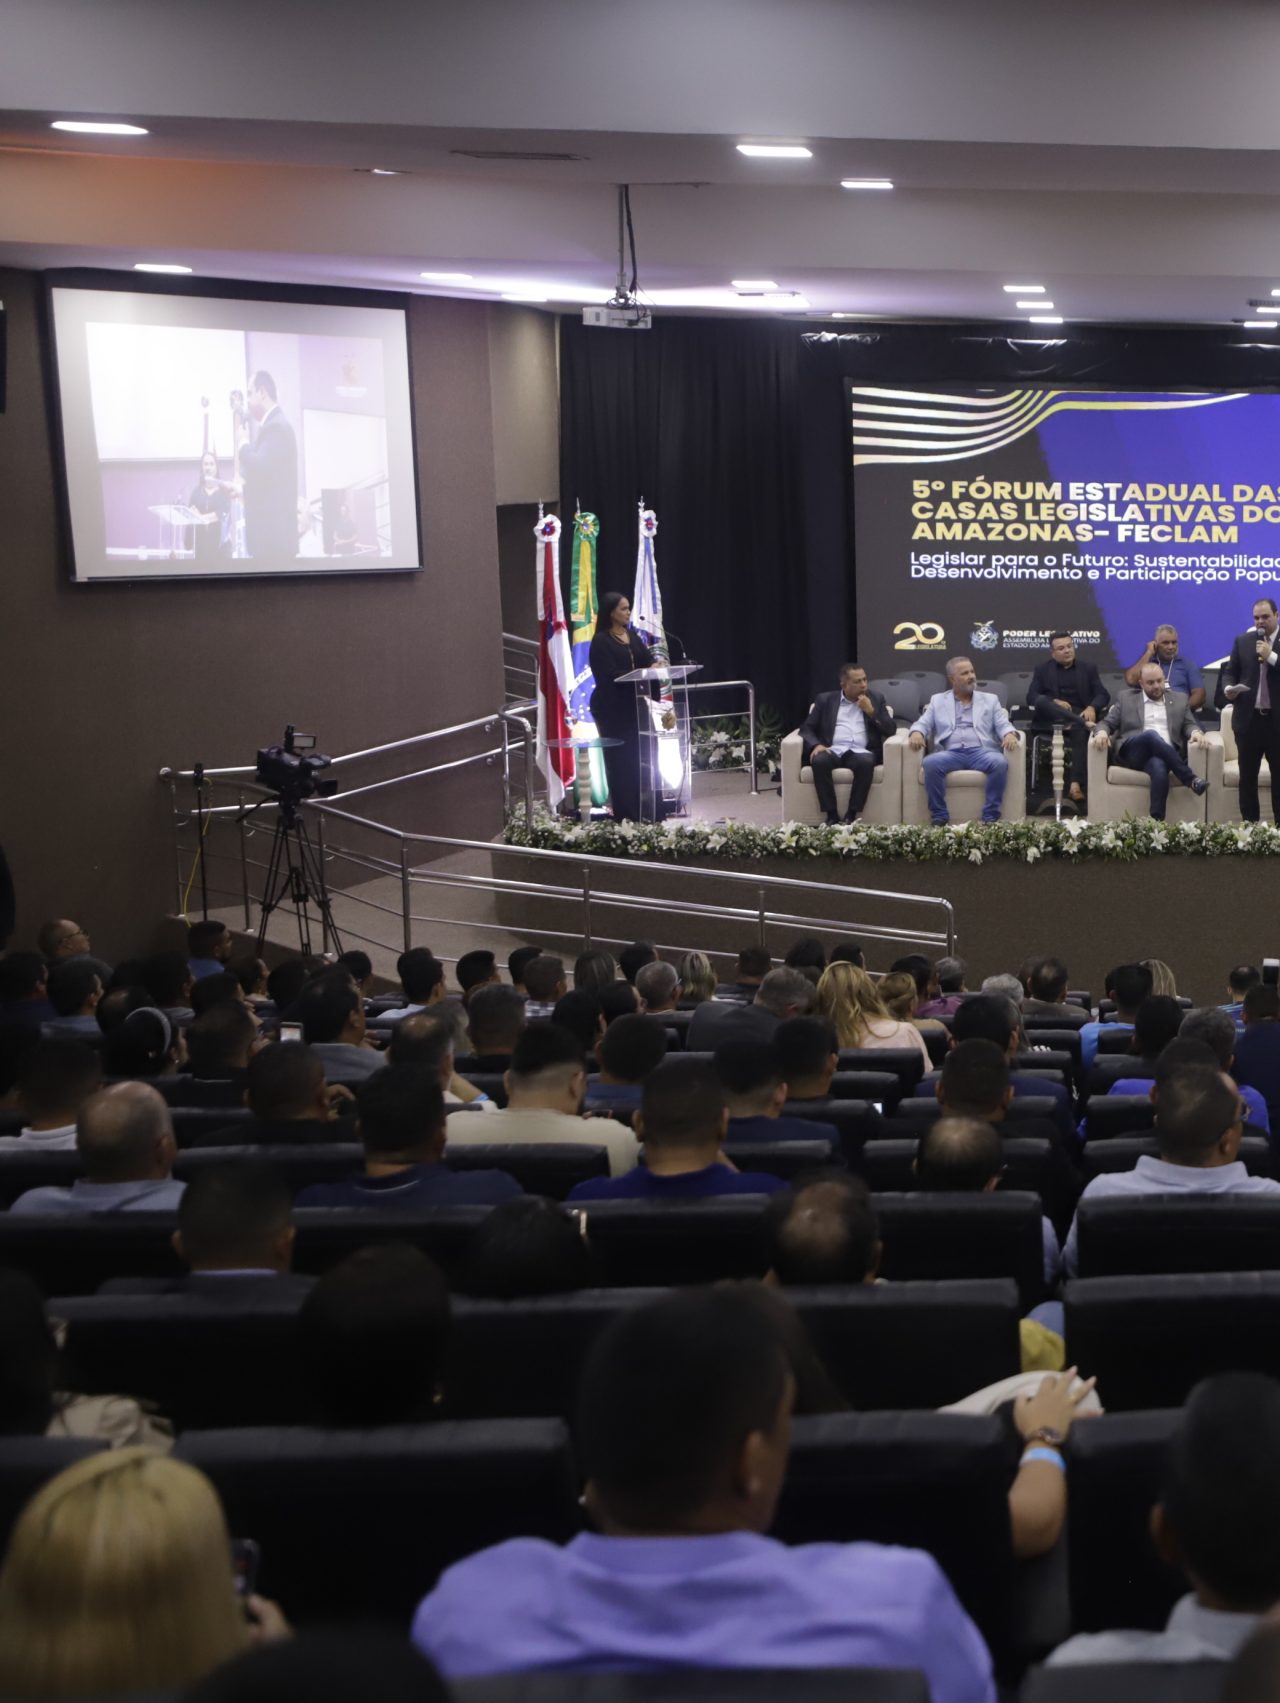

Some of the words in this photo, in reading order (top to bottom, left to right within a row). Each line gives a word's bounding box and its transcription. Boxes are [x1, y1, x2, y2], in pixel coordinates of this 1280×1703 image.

[952, 475, 1062, 500] FÓRUM
[1069, 482, 1227, 502] ESTADUAL
[911, 501, 1018, 521] CASAS
[1025, 502, 1236, 523] LEGISLATIVAS
[1117, 524, 1239, 543] FECLAM
[911, 551, 986, 568] Legislar
[991, 554, 1039, 568] para
[1044, 555, 1057, 566] o
[1062, 553, 1129, 567] Futuro:
[911, 565, 1082, 579] Desenvolvimento
[1087, 568, 1100, 580] e
[1105, 567, 1230, 585] Participação
[1002, 630, 1037, 638] PODER
